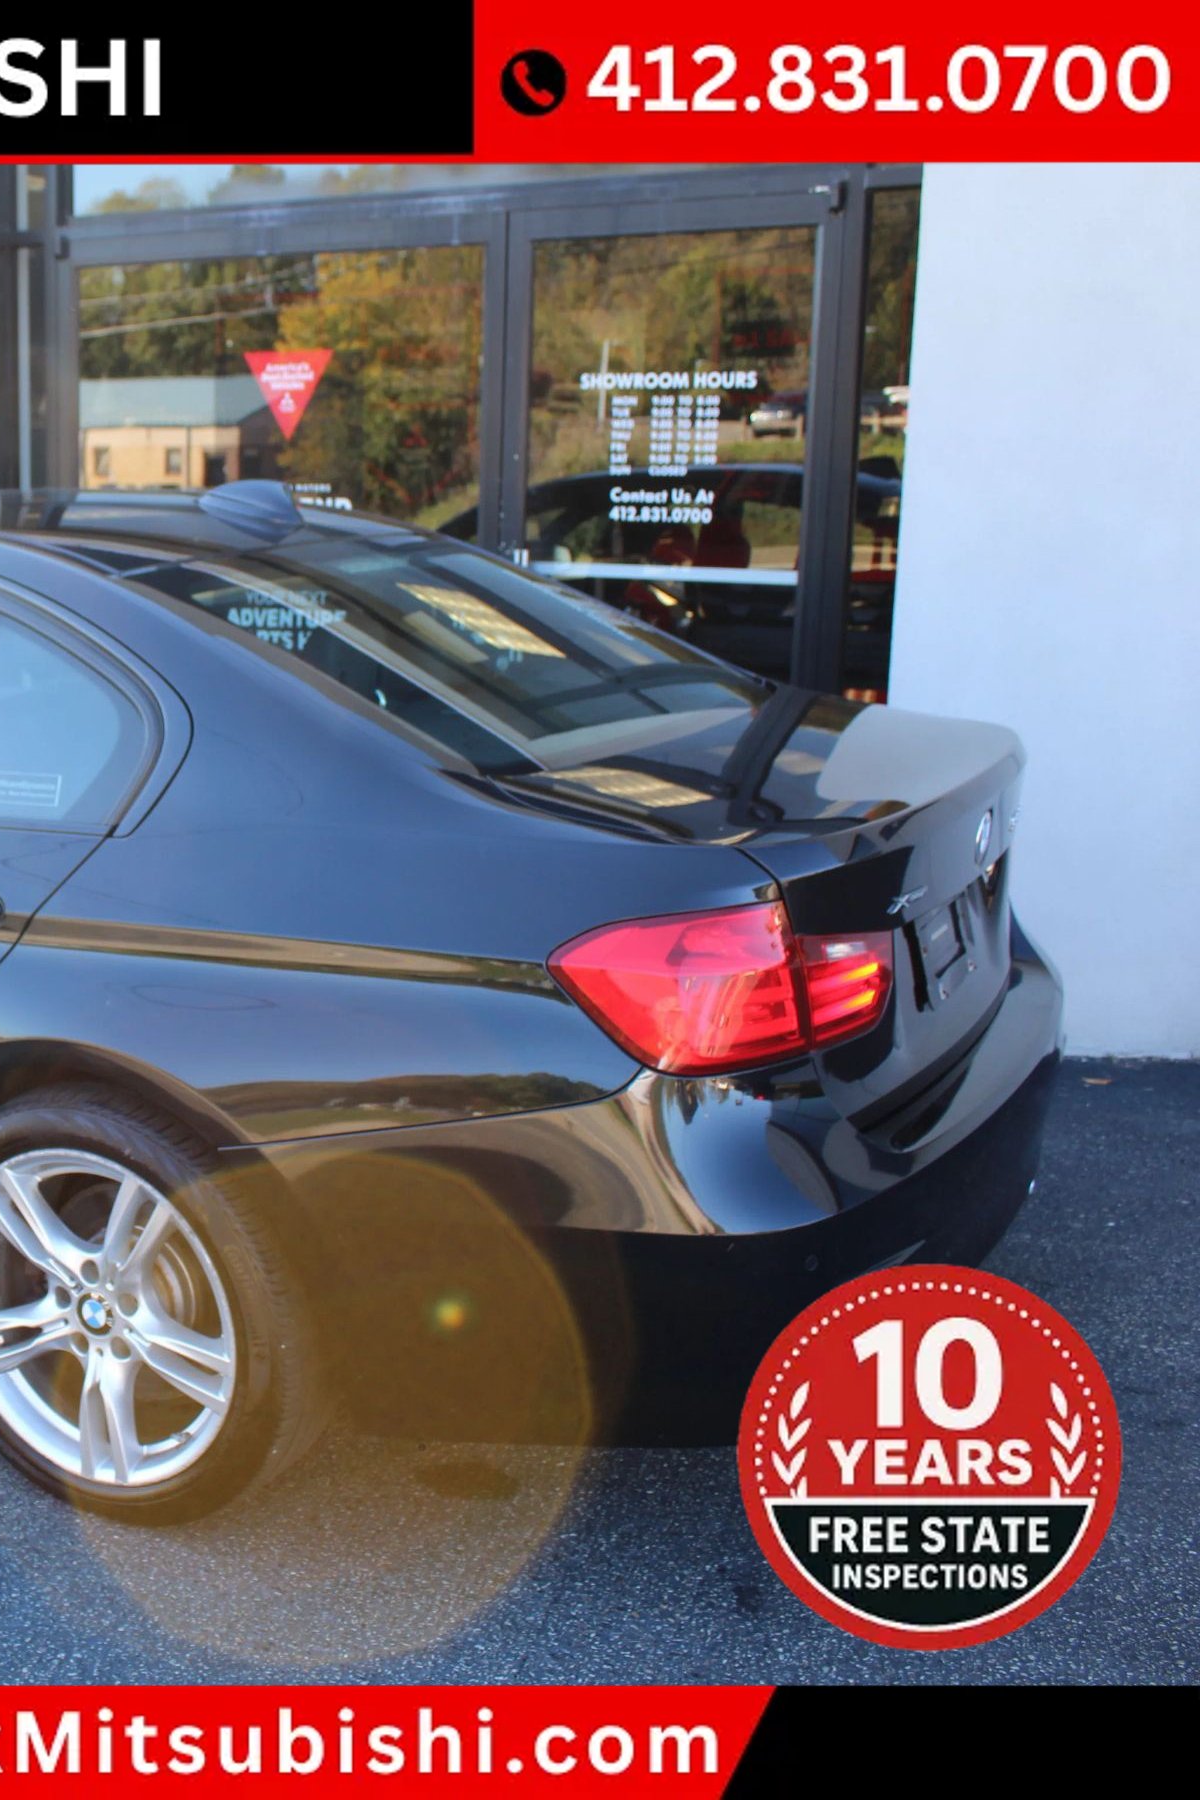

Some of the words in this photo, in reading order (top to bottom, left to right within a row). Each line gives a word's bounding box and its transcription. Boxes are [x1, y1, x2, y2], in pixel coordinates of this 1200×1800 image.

[580, 372, 689, 390] SHOWROOM
[693, 371, 758, 389] HOURS
[609, 487, 668, 505] Contact
[671, 488, 692, 505] Us
[695, 490, 715, 505] At
[608, 506, 713, 524] 412.831.0700
